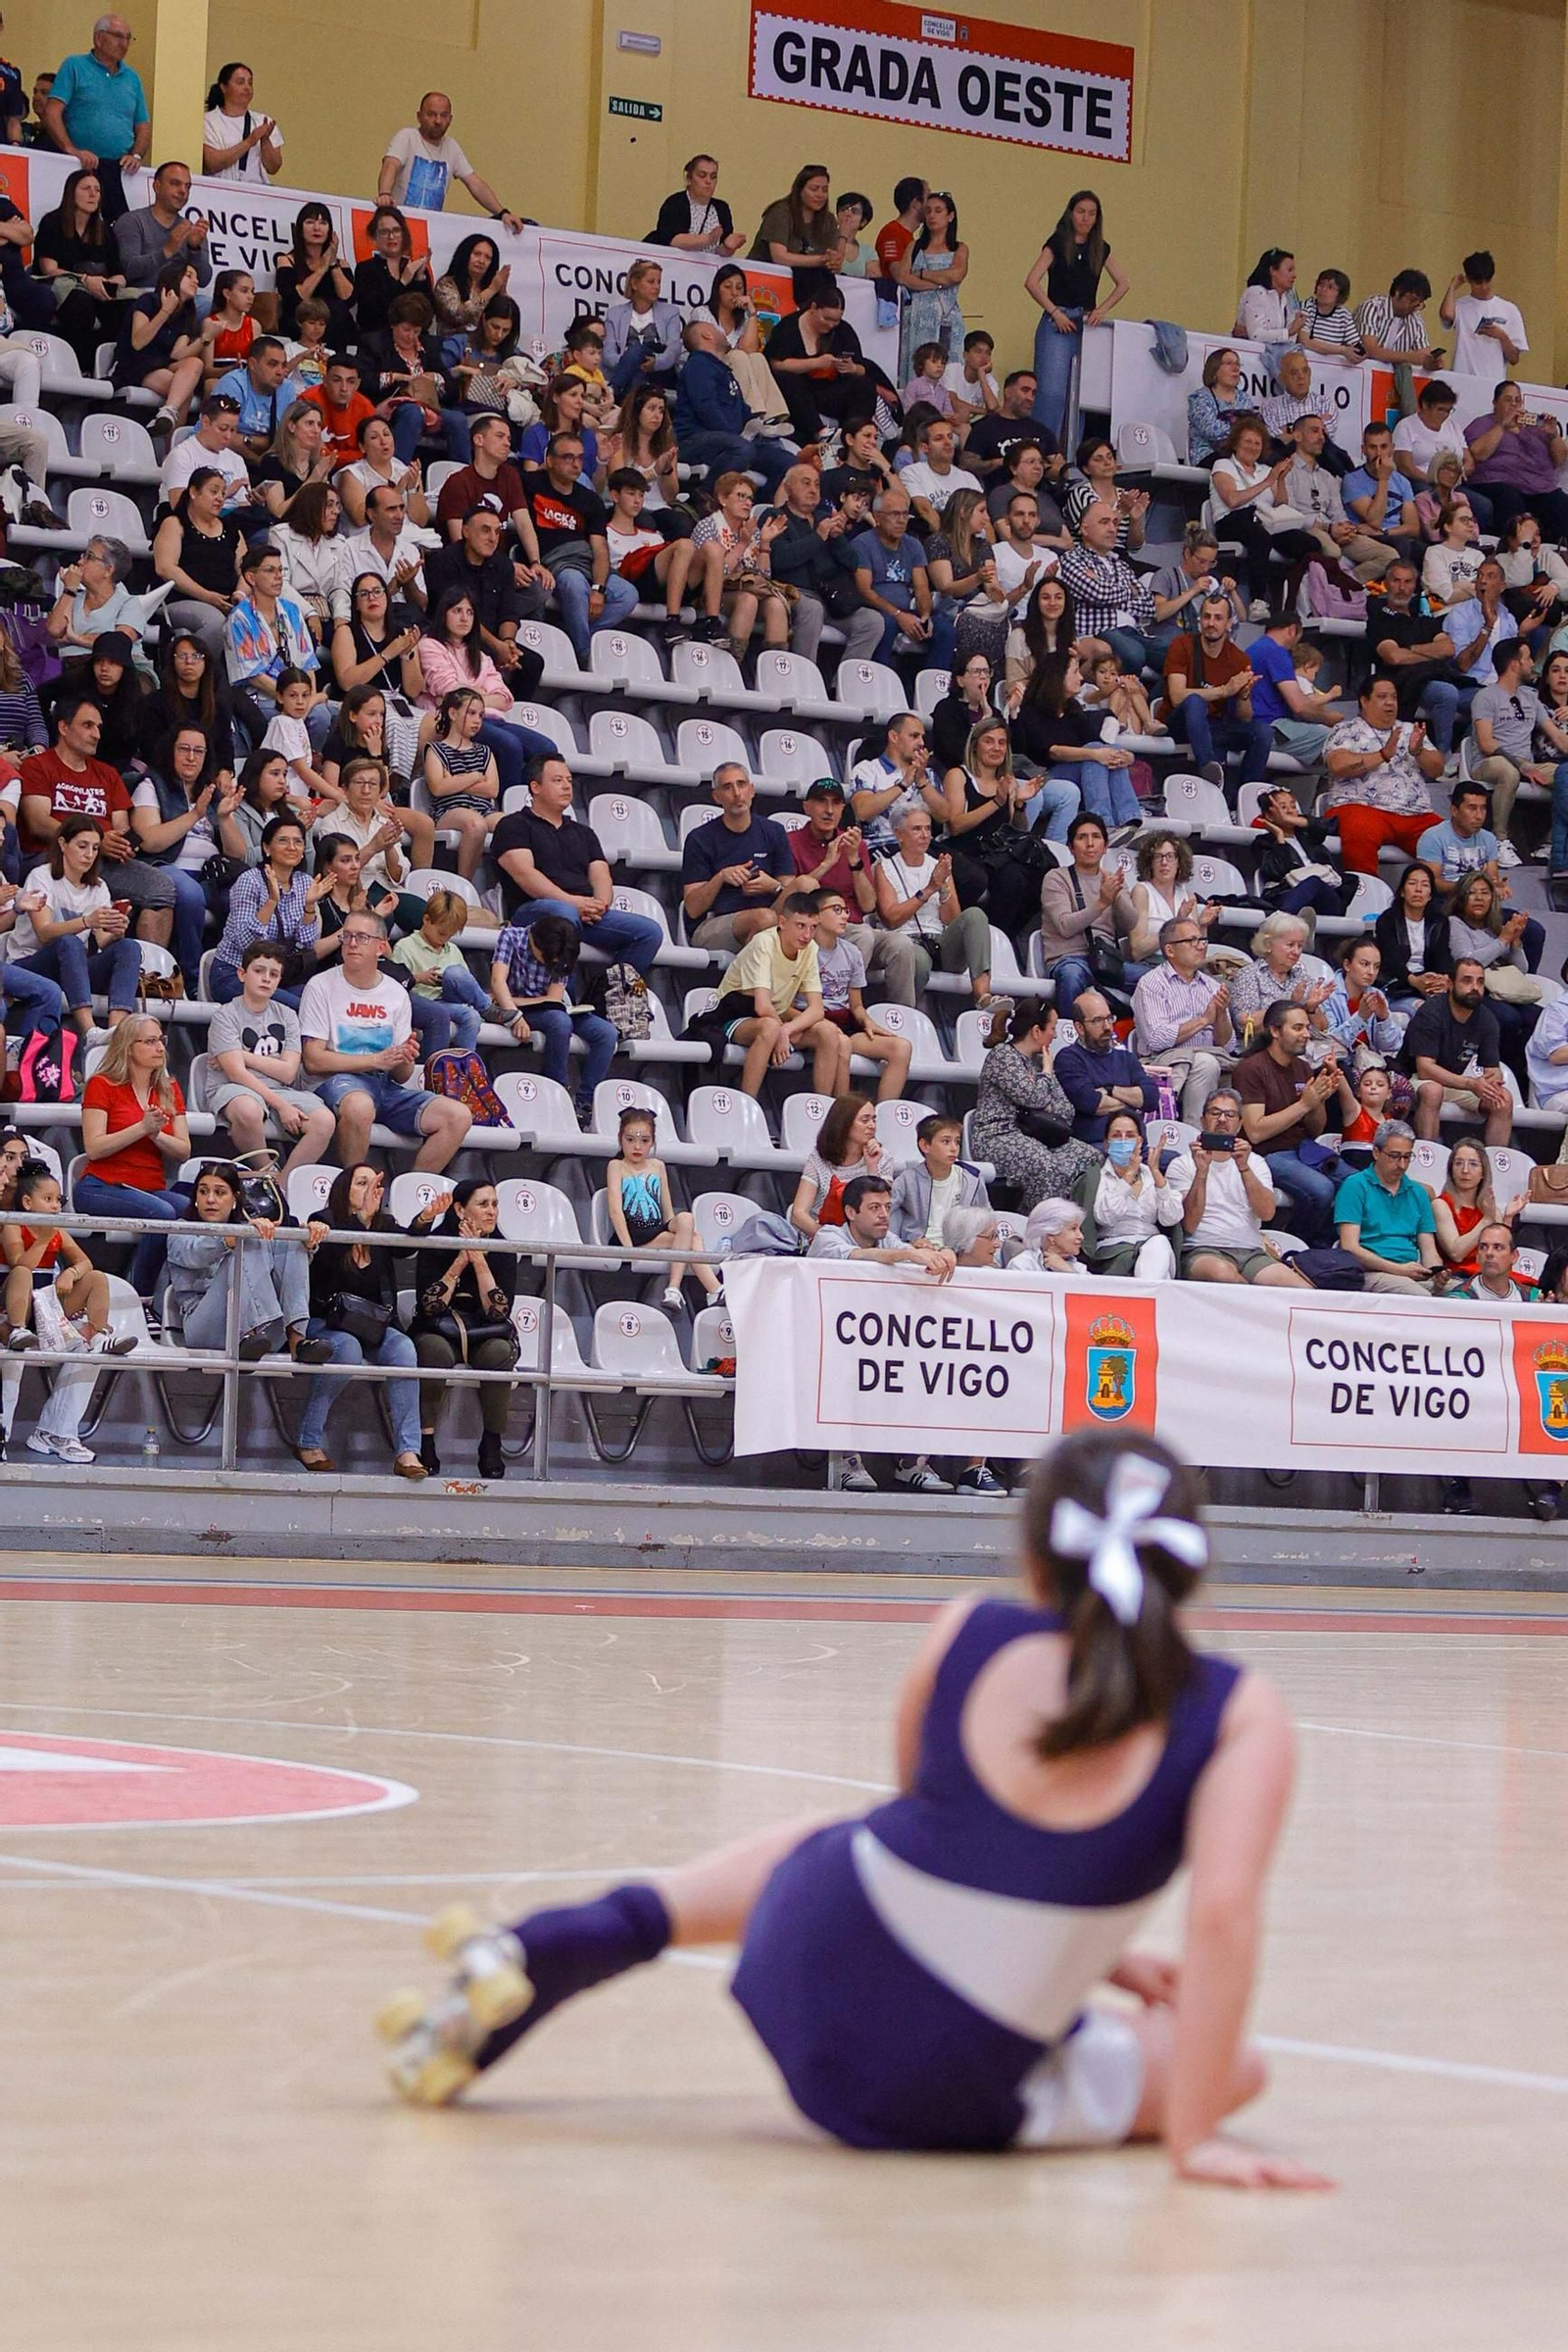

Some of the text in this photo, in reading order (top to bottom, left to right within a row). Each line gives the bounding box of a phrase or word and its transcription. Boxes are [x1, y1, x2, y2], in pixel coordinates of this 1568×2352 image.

[924, 20, 954, 30] CONCELLO
[772, 31, 1113, 139] GRADA OESTE
[612, 100, 645, 116] SALIDA
[619, 902, 627, 911] 12
[346, 1003, 387, 1019] JAWS
[524, 1085, 529, 1094] 9
[811, 1105, 819, 1114] 12
[523, 1198, 528, 1207] 8
[719, 1211, 728, 1220] 10
[627, 1321, 632, 1330] 8
[726, 1327, 731, 1336] 9
[836, 1311, 1033, 1354] CONCELLO
[1306, 1338, 1484, 1378] CONCELLO
[858, 1358, 1009, 1397] DE VIGO
[1331, 1382, 1470, 1419] DE VIGO
